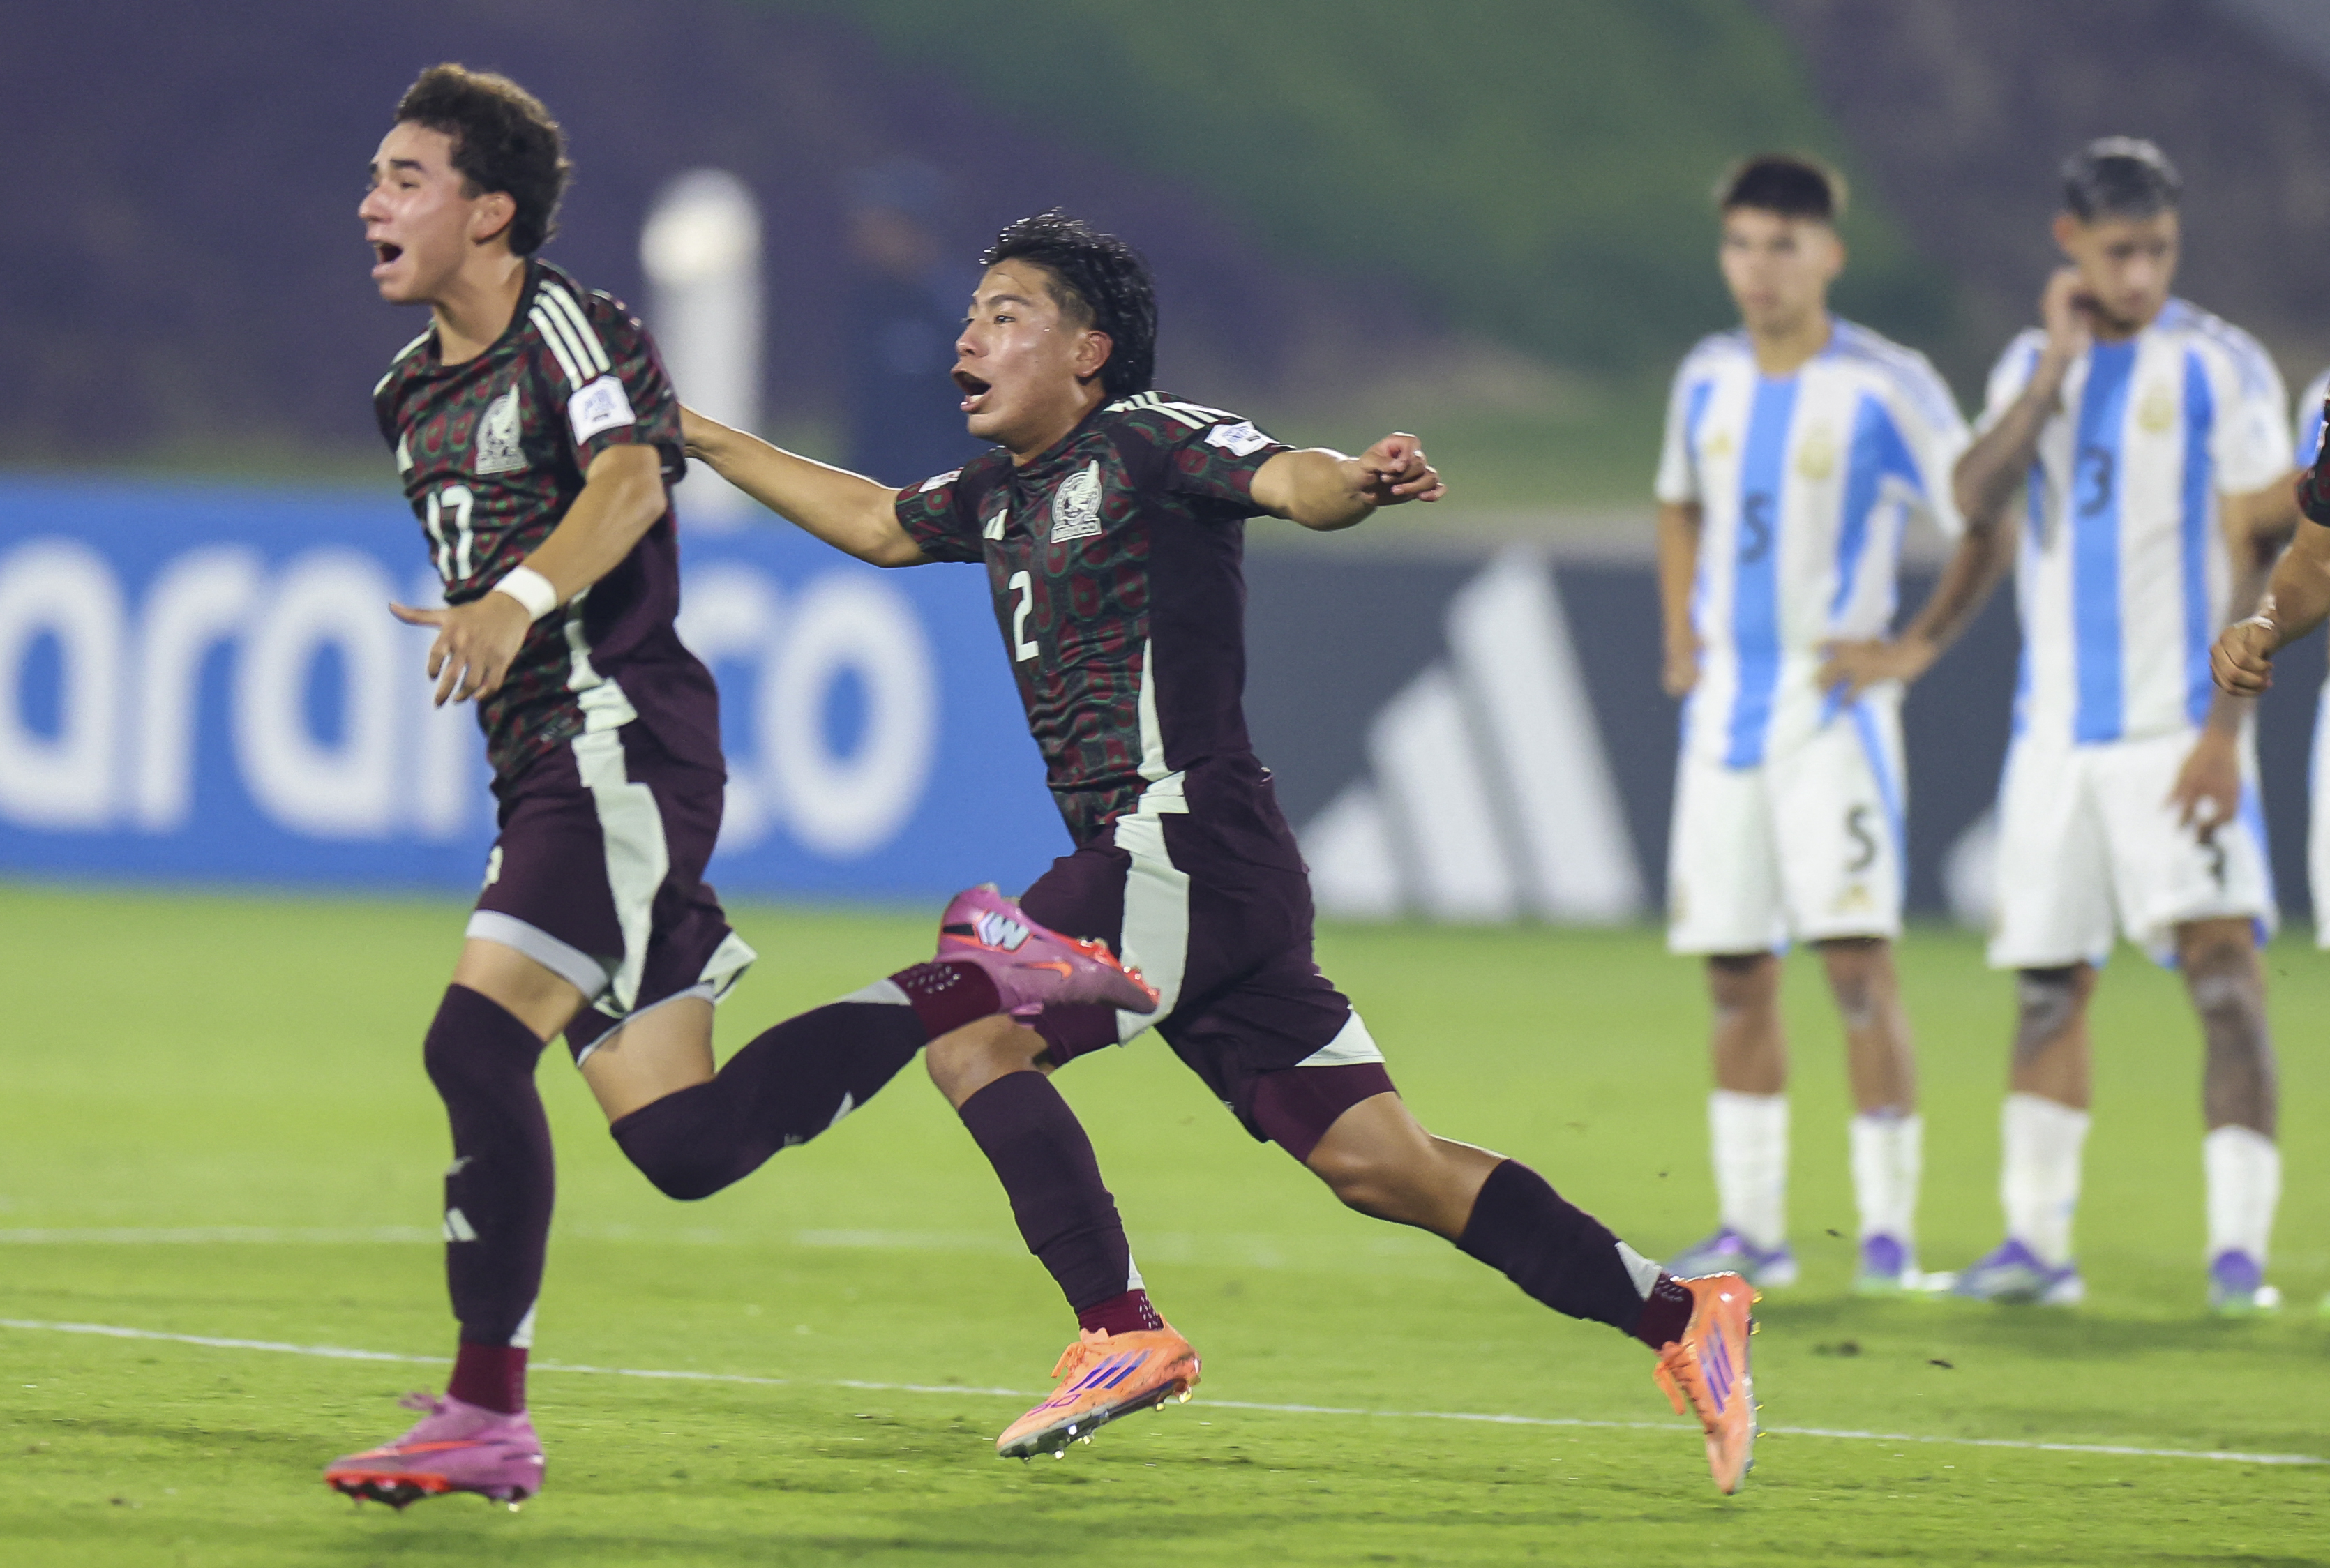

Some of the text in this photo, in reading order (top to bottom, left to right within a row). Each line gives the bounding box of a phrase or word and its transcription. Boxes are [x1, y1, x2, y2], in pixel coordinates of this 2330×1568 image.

[2078, 446, 2114, 519] 3
[427, 485, 474, 581] 17
[1741, 492, 1773, 565] 5
[1008, 570, 1039, 663] 2
[1844, 804, 1877, 873] 5
